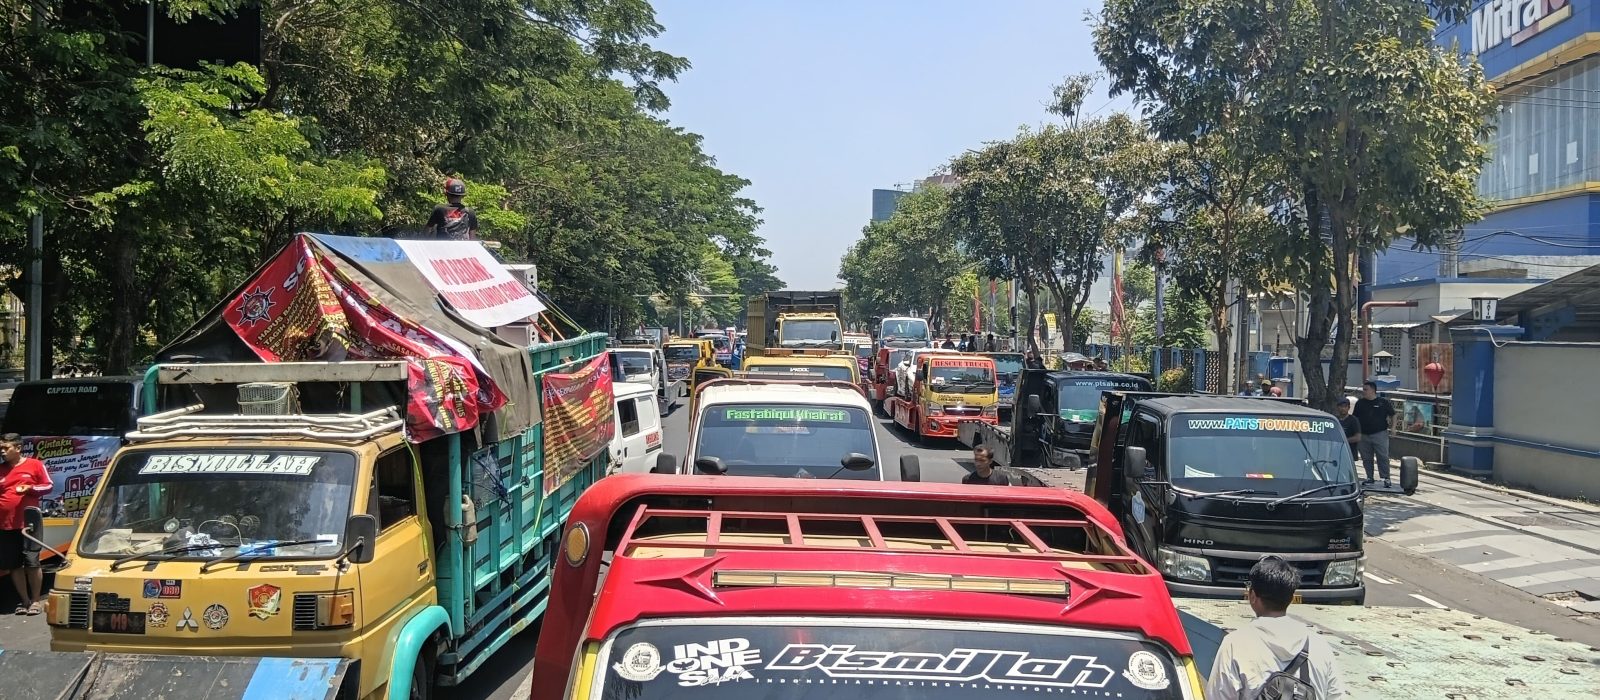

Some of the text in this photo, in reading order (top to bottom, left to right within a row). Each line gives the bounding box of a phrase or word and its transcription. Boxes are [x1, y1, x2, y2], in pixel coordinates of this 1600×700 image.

[257, 315, 284, 341] HAPUS
[263, 323, 287, 346] TAGIH
[46, 386, 78, 394] CAPTAIN
[36, 438, 73, 451] Cintaku
[37, 446, 74, 460] Kandas
[138, 454, 321, 475] BISMILLAH
[1183, 538, 1214, 546] HINO
